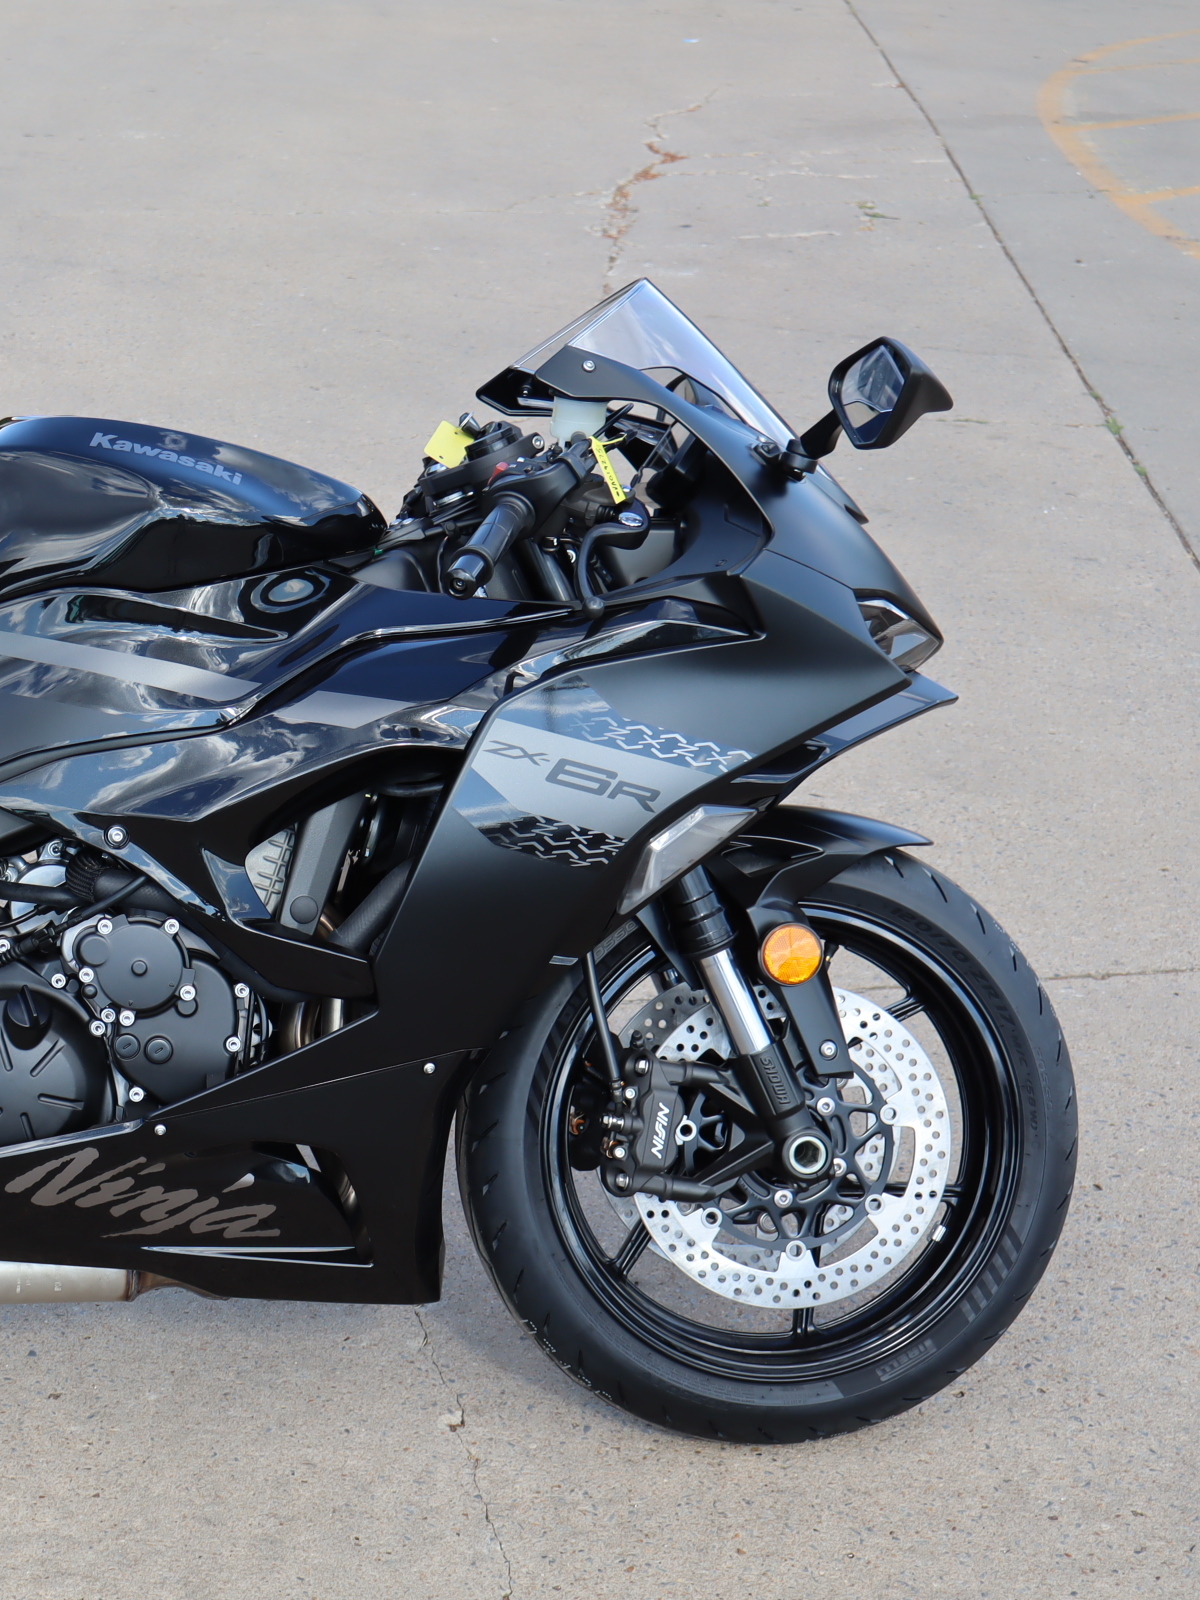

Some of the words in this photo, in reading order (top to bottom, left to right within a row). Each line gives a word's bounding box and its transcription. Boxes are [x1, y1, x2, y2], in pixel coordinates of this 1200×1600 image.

[89, 432, 242, 485] Kawasaki
[593, 919, 638, 958] OSSO
[760, 1056, 790, 1105] SHOWA
[651, 1102, 670, 1159] NISSIN
[4, 1147, 281, 1239] Ninja
[874, 1338, 938, 1382] PIRELLI
